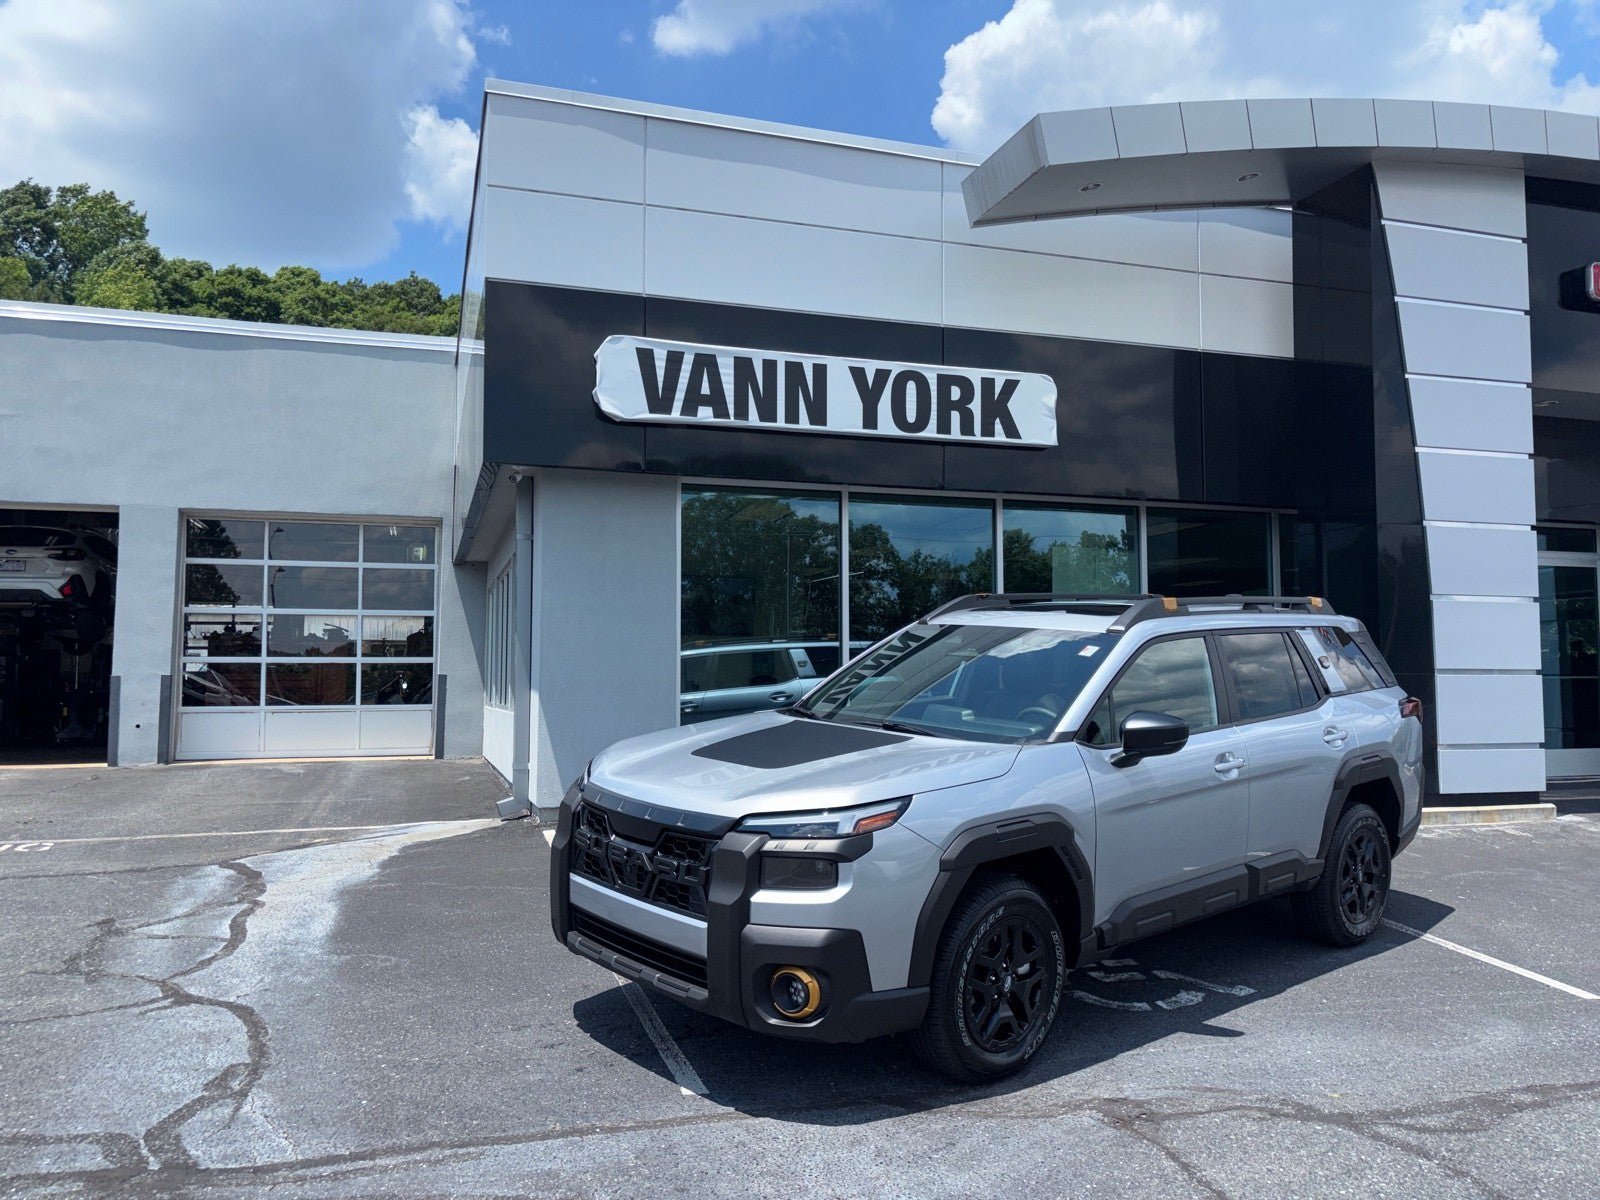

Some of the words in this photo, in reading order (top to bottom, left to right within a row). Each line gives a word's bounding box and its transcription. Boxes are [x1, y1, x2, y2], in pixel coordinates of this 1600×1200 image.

[635, 347, 827, 427] VANN
[847, 365, 1022, 440] YORK
[574, 829, 711, 885] SUBARU
